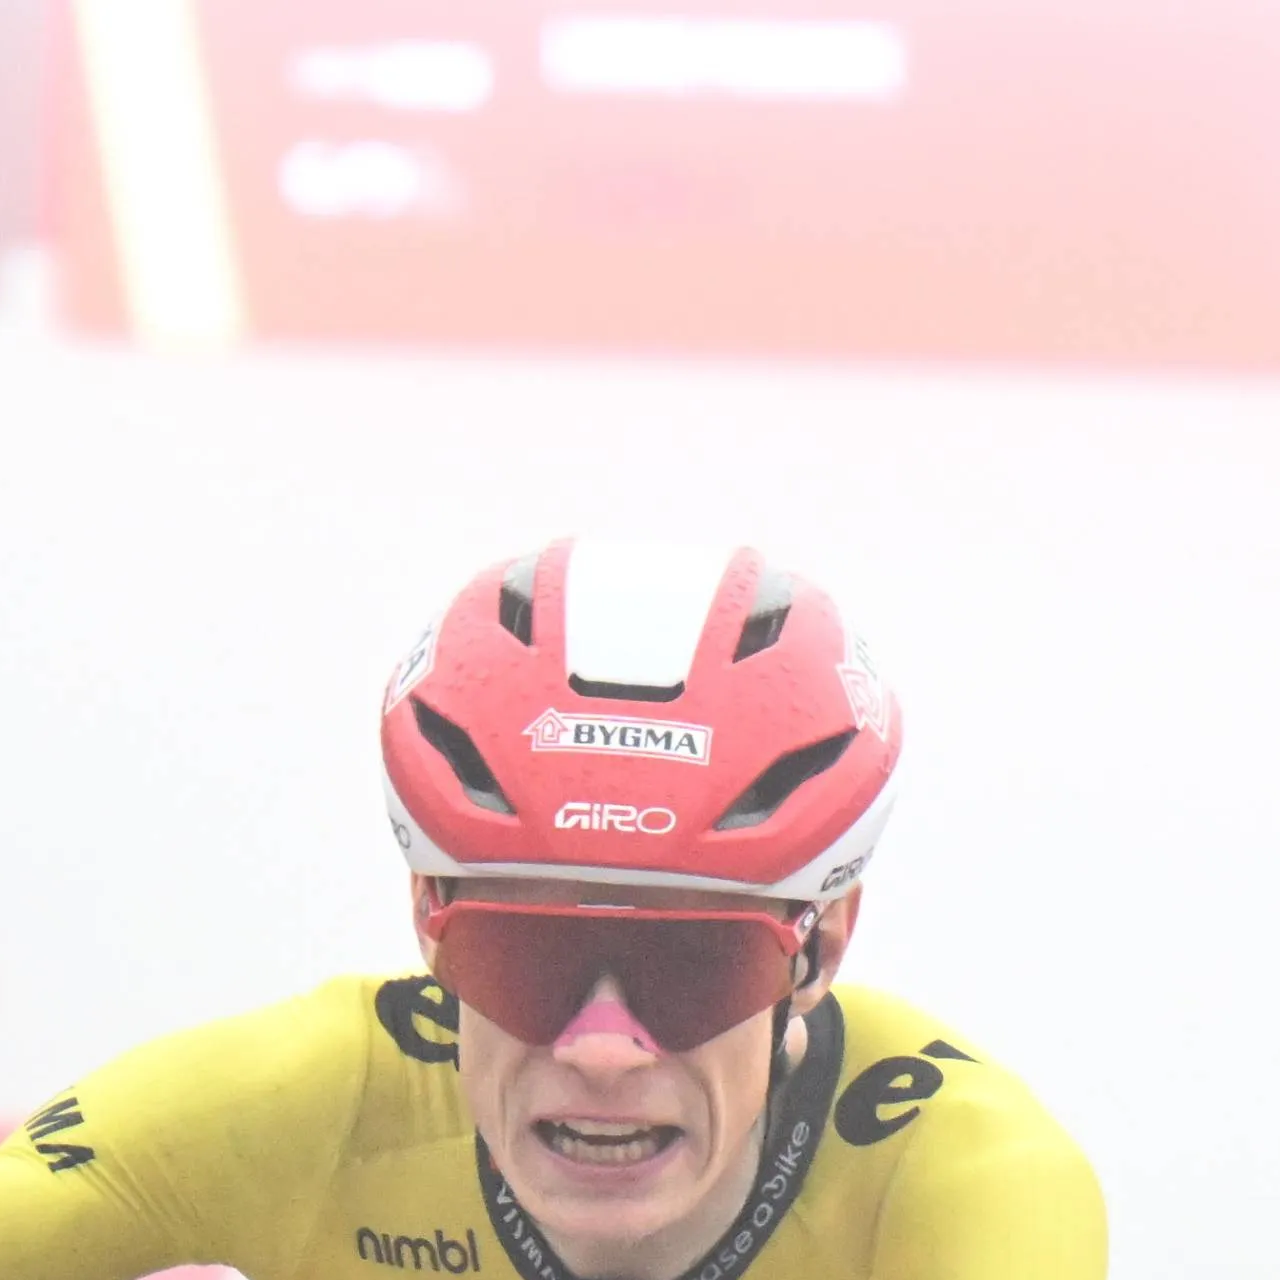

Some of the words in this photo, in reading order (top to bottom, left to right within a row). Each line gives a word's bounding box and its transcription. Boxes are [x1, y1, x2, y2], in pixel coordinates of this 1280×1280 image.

[573, 722, 699, 757] BYGMA
[555, 802, 676, 834] GIRO
[356, 1227, 481, 1274] nimbl
